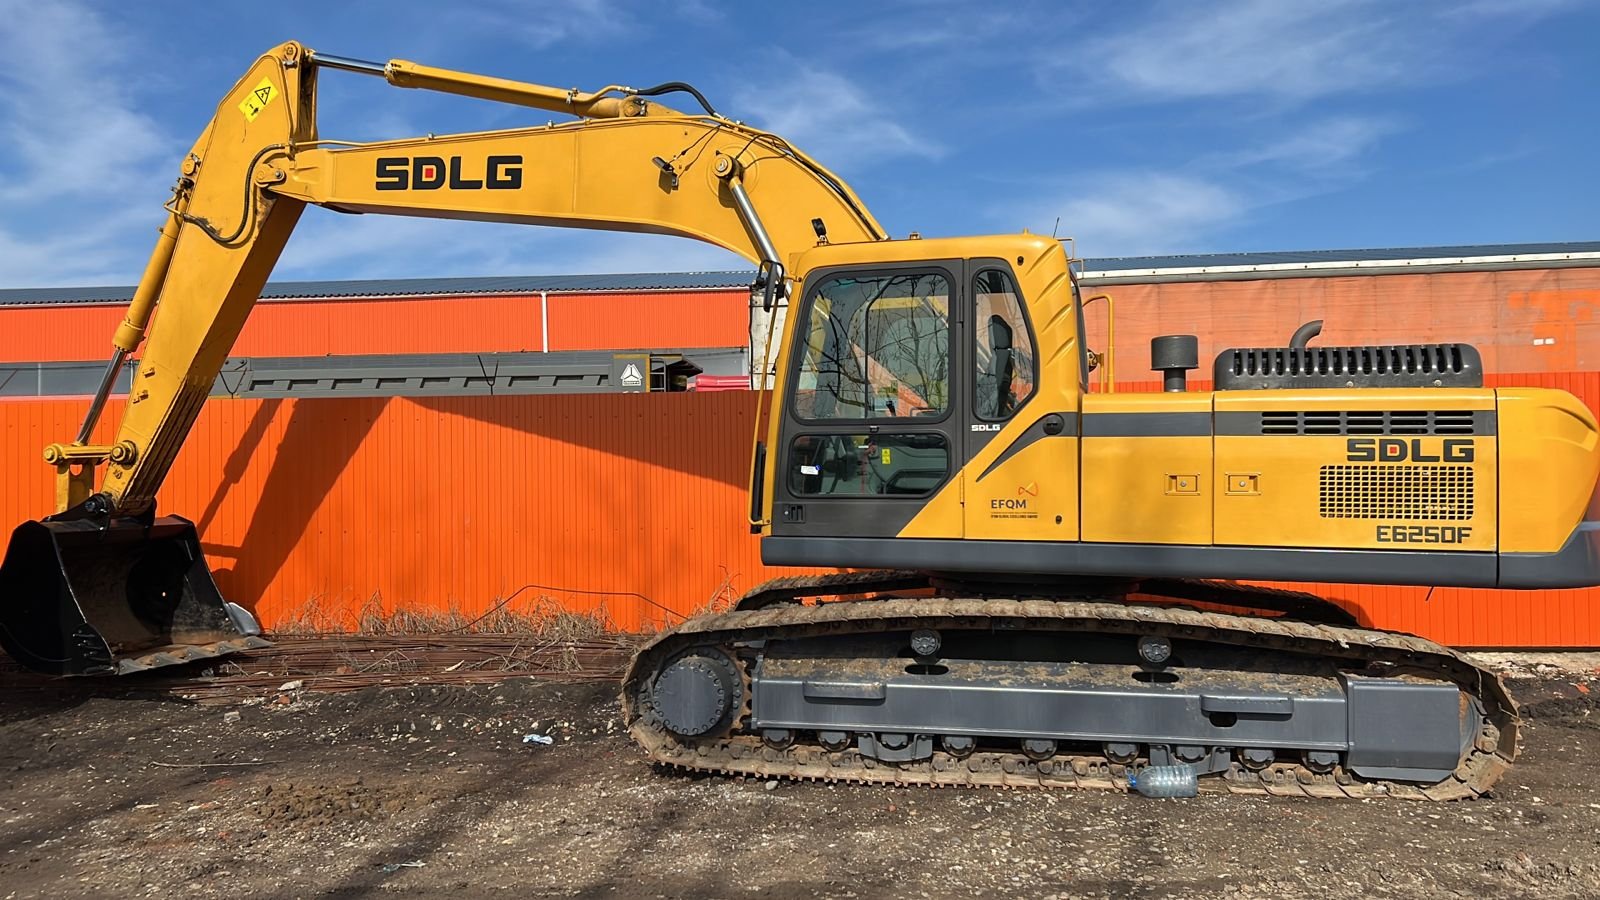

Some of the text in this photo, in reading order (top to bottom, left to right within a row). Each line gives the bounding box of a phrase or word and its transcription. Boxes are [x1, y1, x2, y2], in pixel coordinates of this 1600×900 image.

[375, 155, 523, 190] SDLG
[971, 424, 1001, 432] SDLG
[1347, 439, 1474, 463] SDLG
[991, 499, 1027, 510] EFQM
[1376, 525, 1473, 543] E6250F
